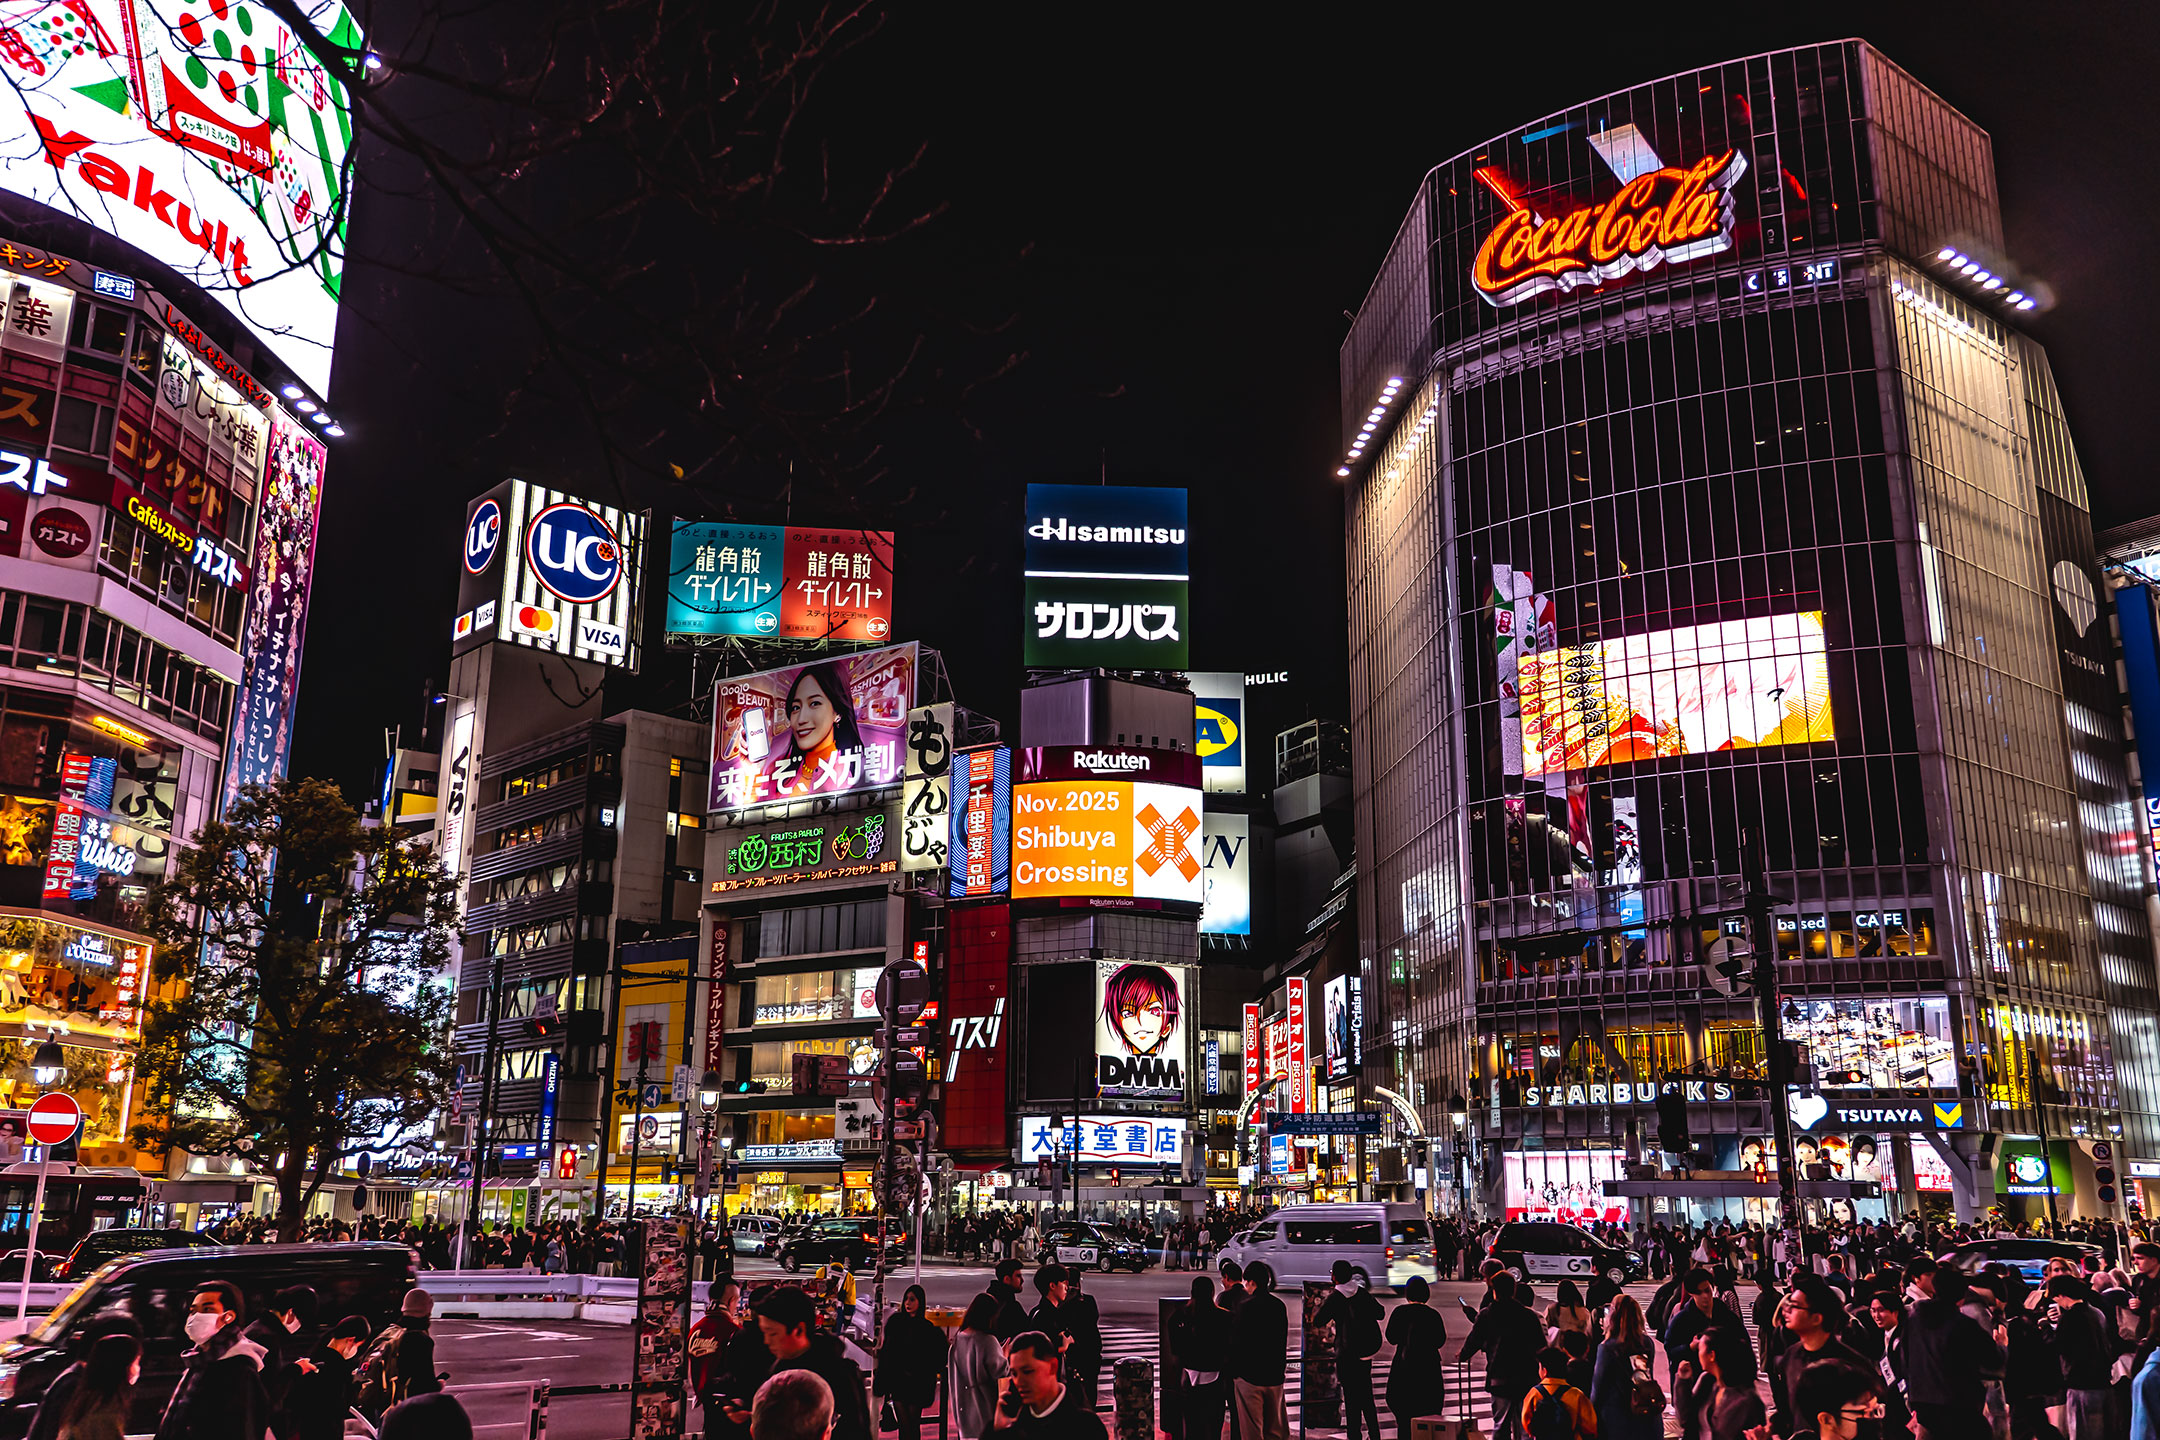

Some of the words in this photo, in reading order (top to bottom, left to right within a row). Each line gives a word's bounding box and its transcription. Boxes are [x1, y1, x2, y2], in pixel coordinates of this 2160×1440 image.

[181, 114, 239, 150] スッキリミルク味
[24, 110, 254, 287] Yakult
[1474, 148, 1733, 289] Coca-Cola
[166, 305, 274, 409] しゃぶしゃぶバイキング
[116, 421, 224, 518] コンタクト
[38, 526, 84, 546] ガスト
[128, 496, 194, 552] Caféレストラン
[681, 528, 778, 541] のど、直接、うるおう
[1028, 517, 1186, 545] Hisamitsu
[193, 536, 243, 588] ガスト
[695, 545, 761, 574] 龍角散
[807, 551, 872, 579] 龍角散
[684, 575, 772, 603] ダイレクト
[797, 580, 883, 608] ダイレクト
[478, 607, 493, 623] VISA
[757, 617, 775, 628] 生薬
[868, 622, 887, 633] 生薬
[1034, 601, 1180, 642] サロンパス
[582, 625, 621, 649] VISA
[2065, 649, 2105, 676] TSUTAYA
[721, 683, 750, 697] Qoo10
[1245, 671, 1289, 686] HULIC
[1074, 750, 1150, 771] Rakuten
[447, 746, 469, 816] くら
[905, 709, 950, 866] もんじゃ
[967, 757, 988, 887] 三千里薬品
[1017, 826, 1116, 851] Shibuya
[727, 849, 738, 874] 渋谷
[769, 838, 822, 869] 西村
[1016, 860, 1128, 886] Crossing
[1090, 898, 1114, 906] Rakuten
[1115, 898, 1134, 906] Vision
[1777, 916, 1826, 931] based
[1855, 913, 1902, 928] CAFE
[1289, 987, 1304, 1053] カラオケ
[1247, 1030, 1255, 1051] ECHO
[547, 1061, 557, 1093] MIZUHO
[1099, 1055, 1183, 1090] DMM
[1292, 1061, 1300, 1077] BIG
[1292, 1078, 1301, 1104] ECHO
[1837, 1109, 1923, 1122] TSUTAYA
[1032, 1125, 1176, 1153] 大盛堂書店
[2007, 1186, 2060, 1195] STARBUCS
